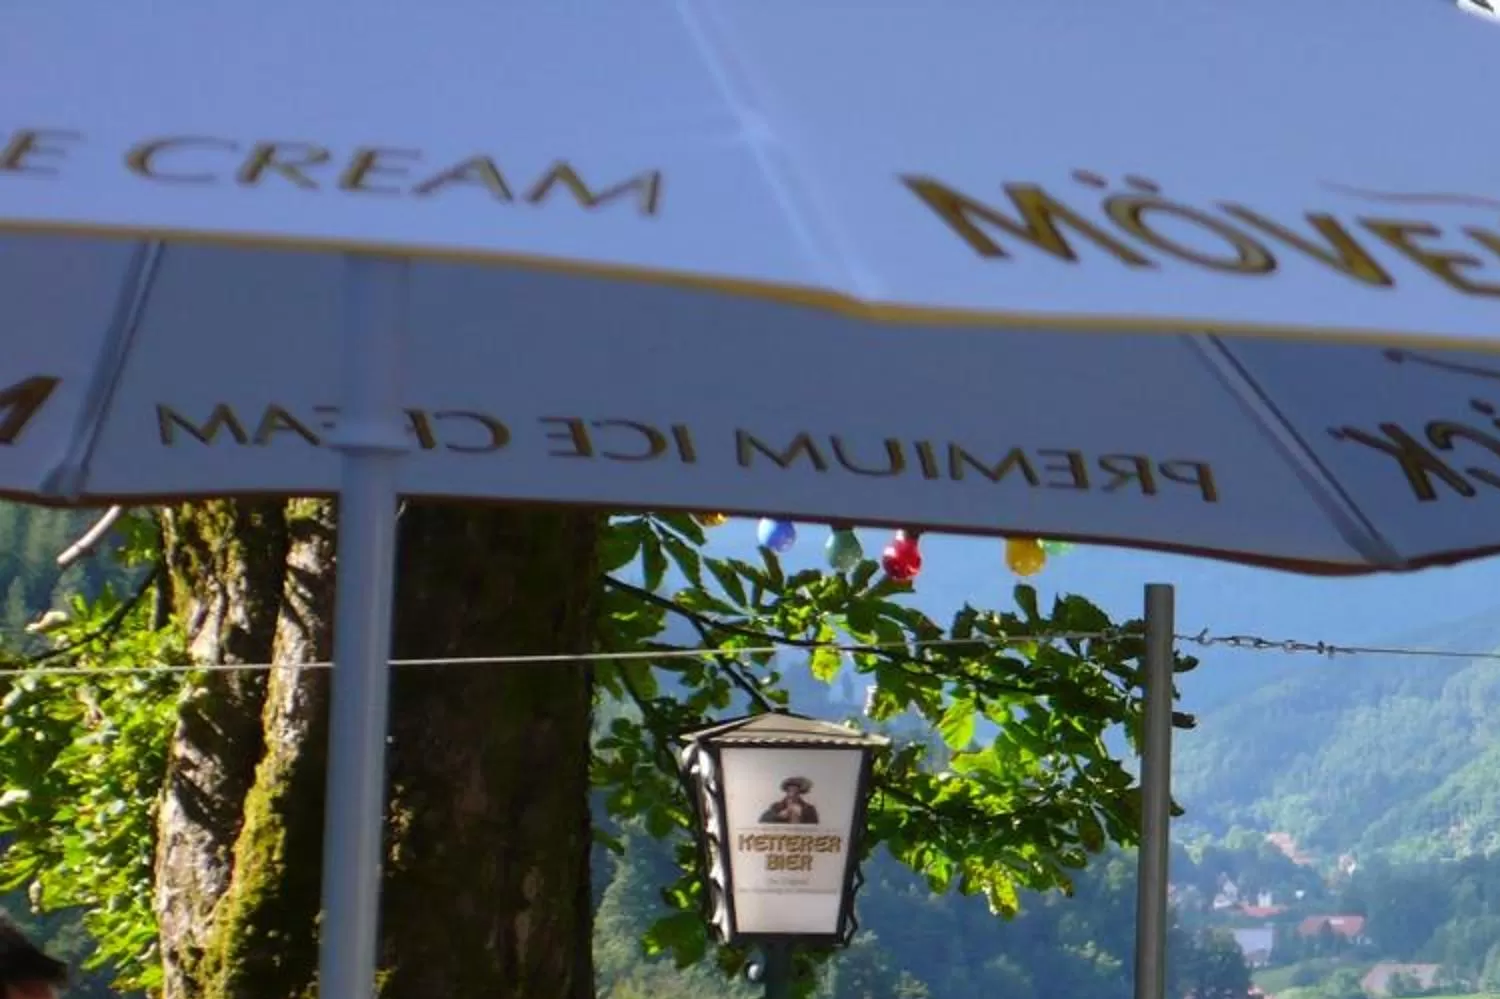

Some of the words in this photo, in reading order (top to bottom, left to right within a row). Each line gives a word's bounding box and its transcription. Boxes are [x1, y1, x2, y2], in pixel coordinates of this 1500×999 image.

[124, 135, 664, 216] CREAM
[737, 834, 842, 853] KETTERER
[764, 854, 813, 872] BIER
